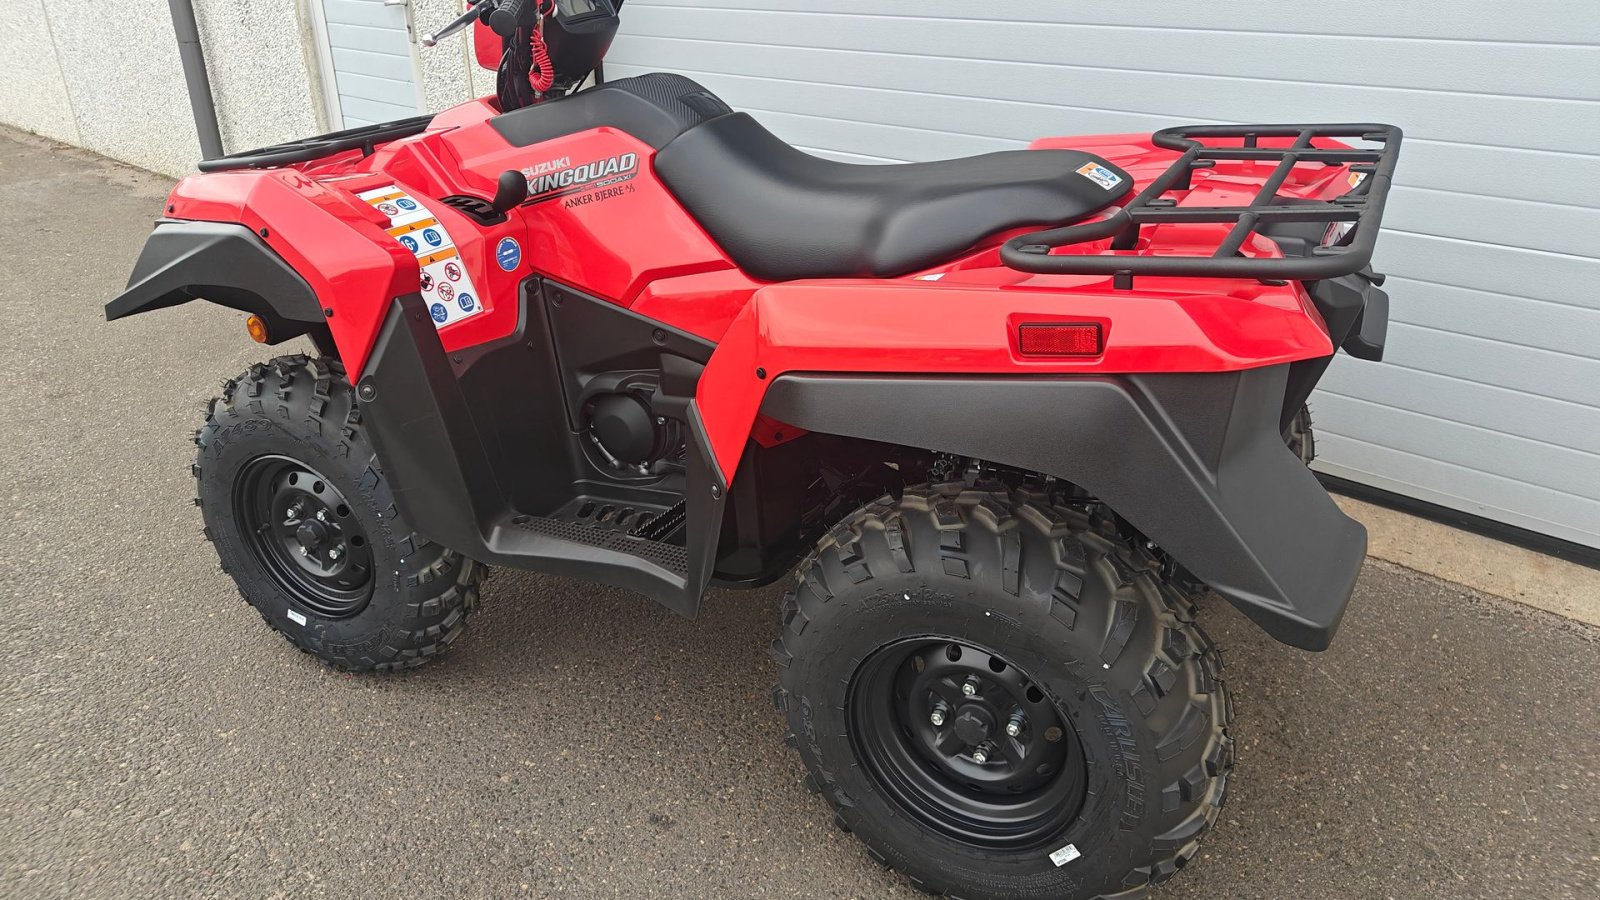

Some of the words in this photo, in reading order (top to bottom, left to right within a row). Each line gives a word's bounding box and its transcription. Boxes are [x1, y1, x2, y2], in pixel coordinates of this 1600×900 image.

[521, 156, 571, 177] SUZUKI
[526, 152, 637, 196] KINGQUAD
[564, 194, 594, 210] ANKER
[594, 185, 625, 204] BJERRE
